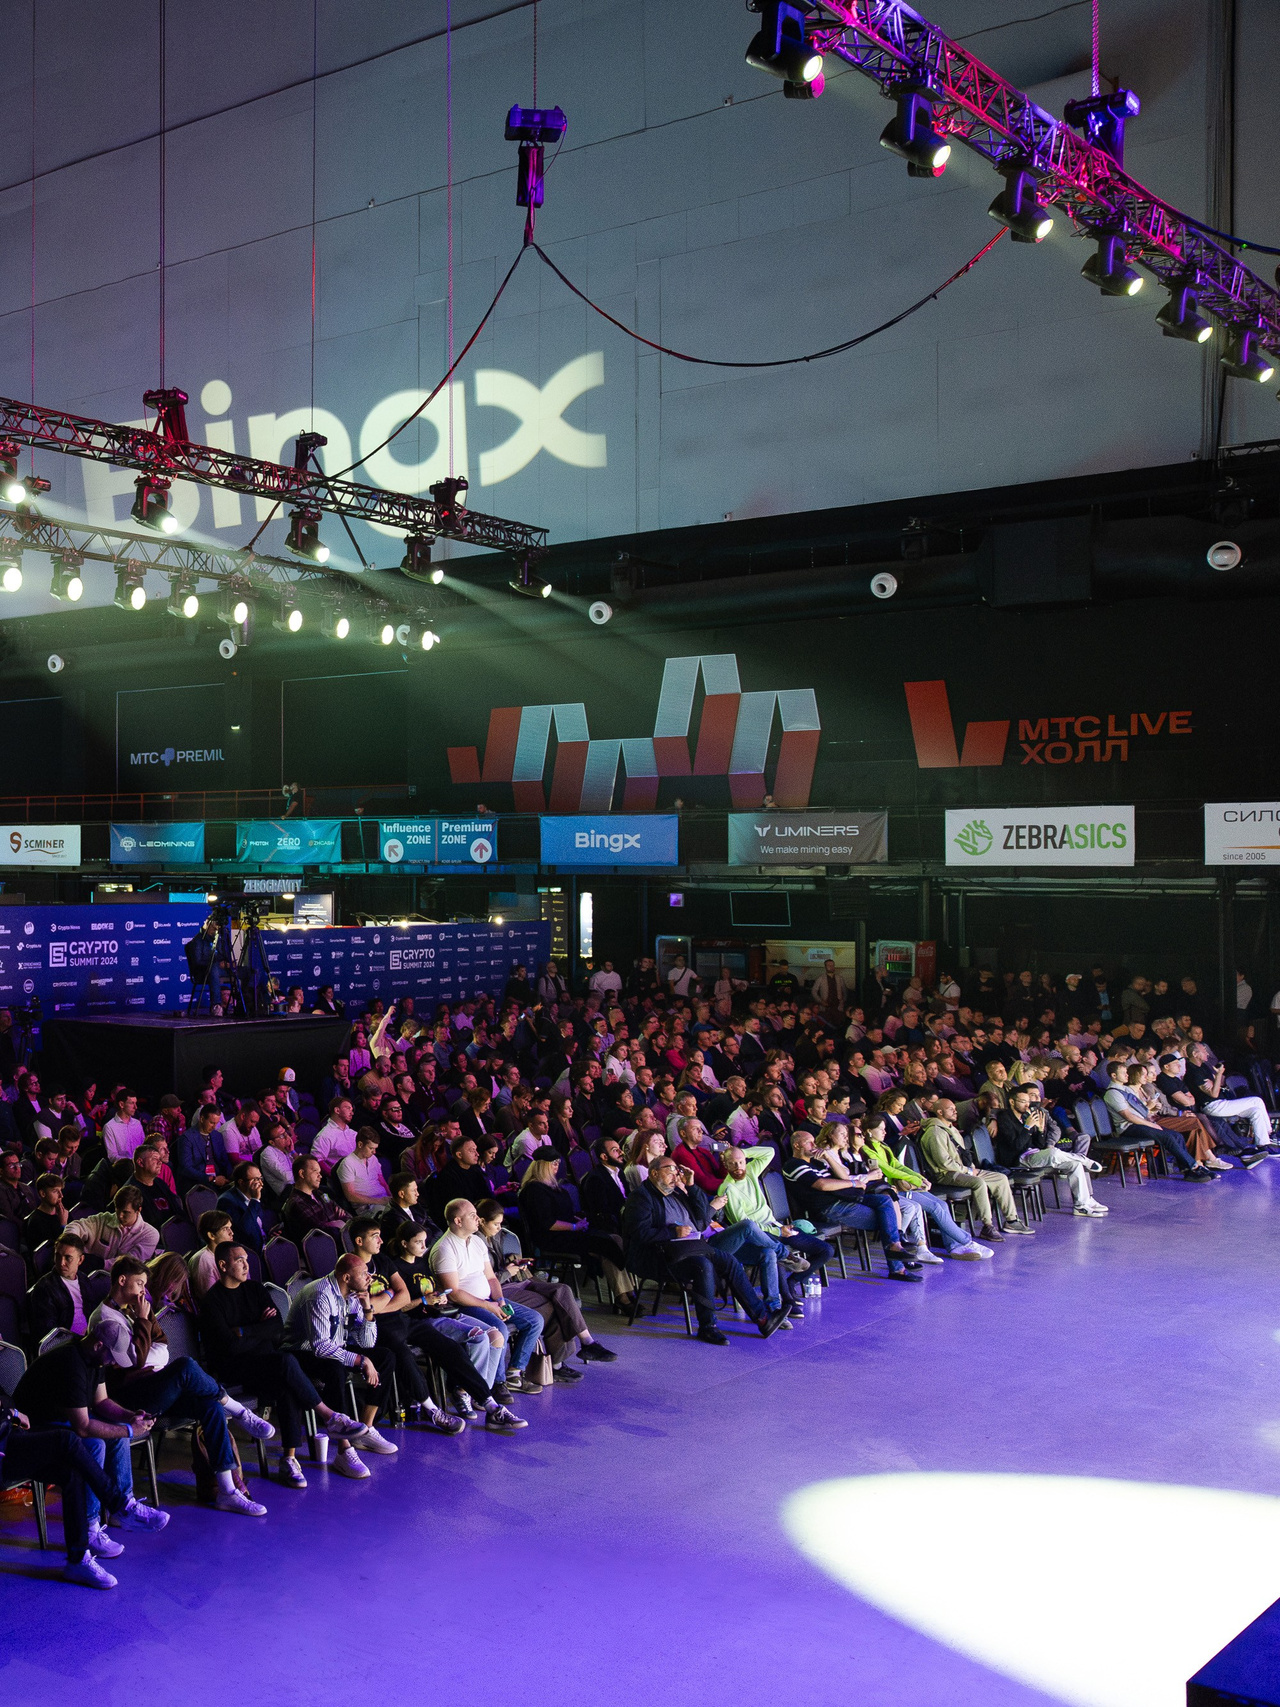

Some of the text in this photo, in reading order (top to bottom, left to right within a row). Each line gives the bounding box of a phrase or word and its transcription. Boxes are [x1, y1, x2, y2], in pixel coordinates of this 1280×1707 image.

[1107, 710, 1193, 738] LIVE
[1019, 738, 1129, 766] ХОЛЛ
[383, 823, 431, 833] Influence
[442, 822, 492, 832] Premium
[775, 825, 860, 837] UMINERS
[277, 837, 301, 846] ZERO
[406, 835, 431, 844] ZONE
[441, 835, 467, 844] ZONE
[1002, 822, 1127, 850] ZEBRASICS
[24, 839, 65, 849] SCMINER
[760, 845, 853, 856] We make mining easy
[1222, 852, 1266, 861] since 2005
[243, 879, 302, 893] ZEROGRAVITY
[69, 940, 118, 955] CRYPTO
[402, 948, 435, 960] CRYPTO
[69, 956, 118, 967] SUMMIT 2024
[403, 961, 422, 969] SUMMIT
